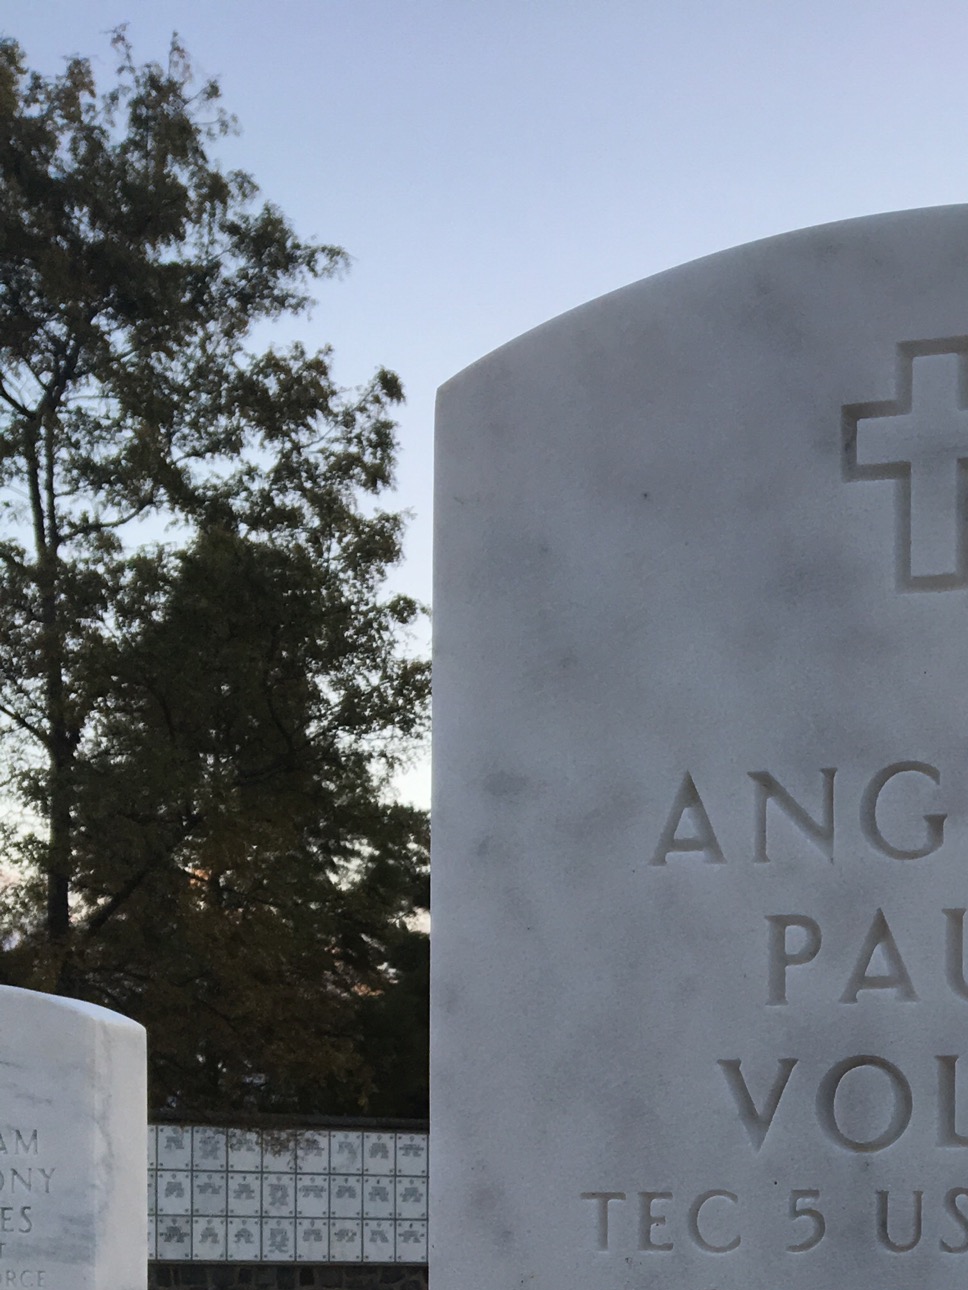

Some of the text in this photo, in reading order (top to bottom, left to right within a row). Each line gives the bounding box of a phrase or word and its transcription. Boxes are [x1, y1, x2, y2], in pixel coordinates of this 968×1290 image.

[0, 1167, 56, 1194] NY
[581, 1188, 742, 1254] TEC
[785, 1188, 826, 1254] 5
[0, 1269, 47, 1288] RCE
